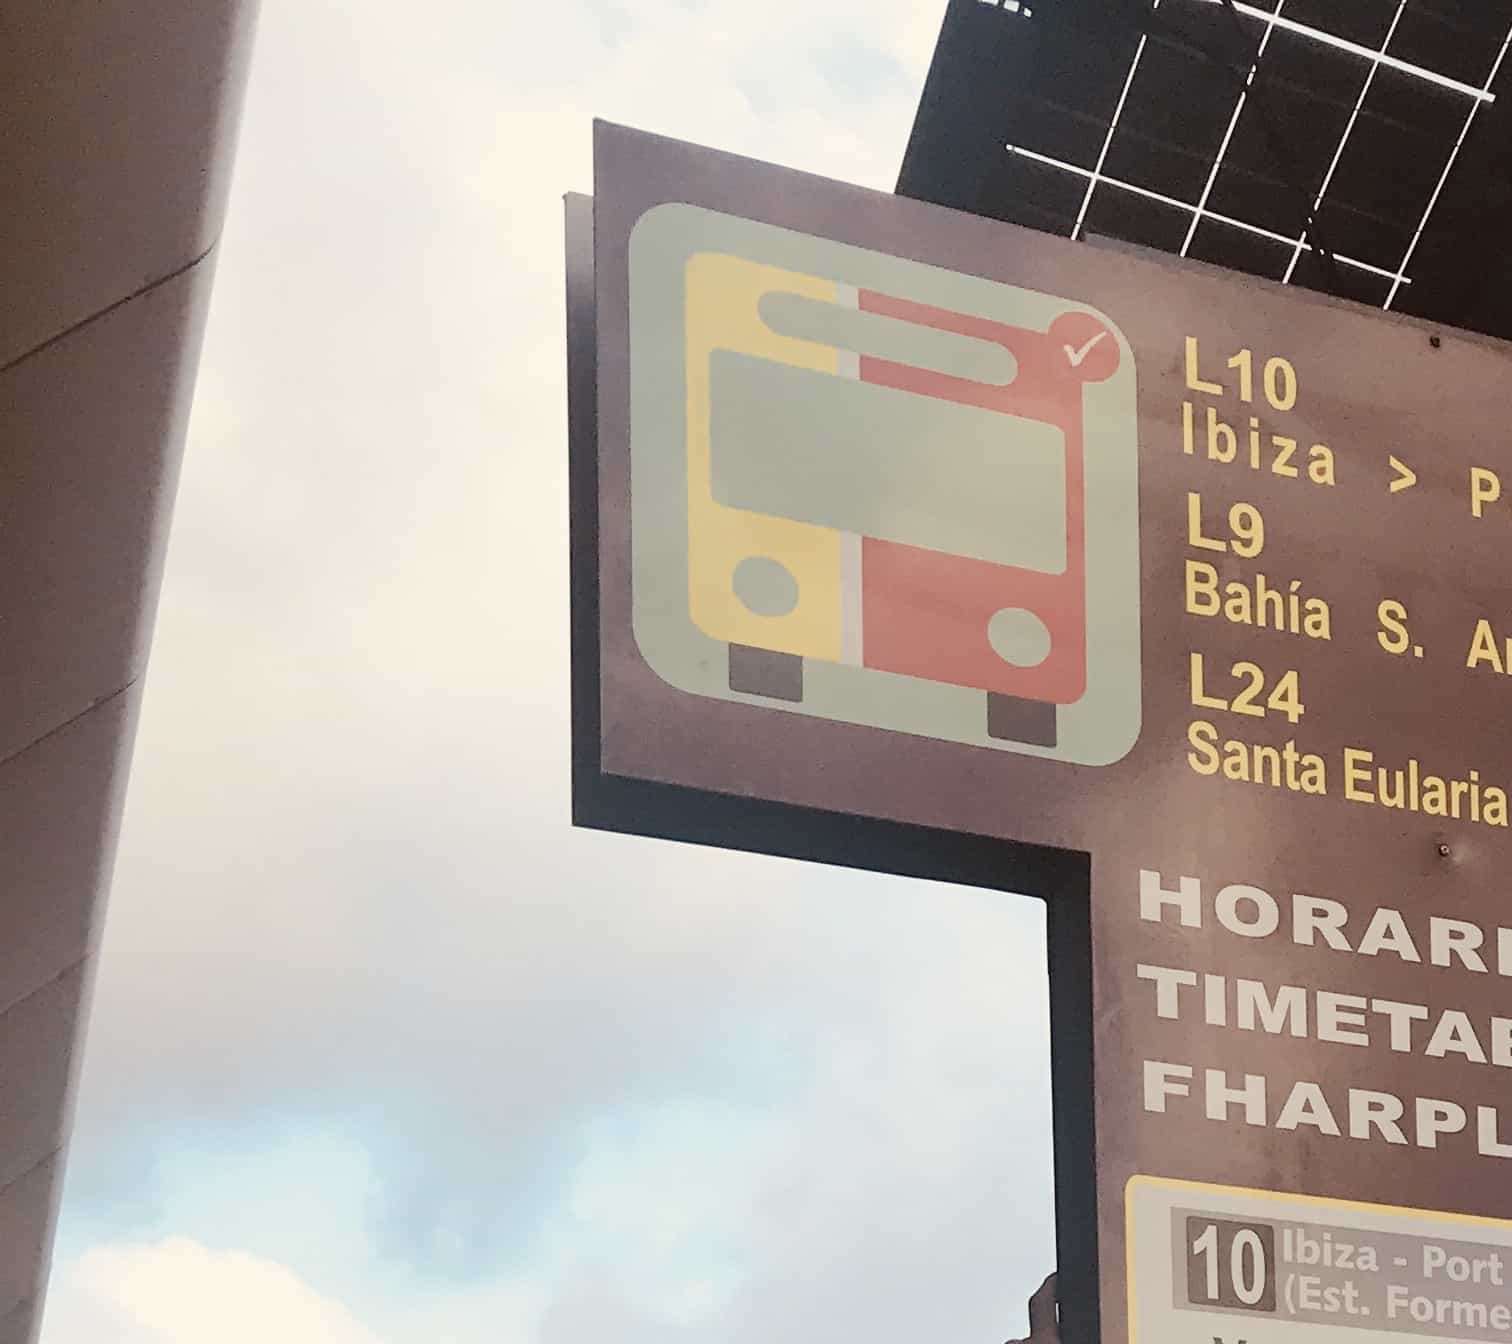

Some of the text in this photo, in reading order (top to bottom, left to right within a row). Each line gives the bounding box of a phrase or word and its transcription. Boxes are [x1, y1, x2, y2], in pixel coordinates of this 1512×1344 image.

[1184, 336, 1297, 410] L10
[1181, 403, 1335, 486] Ibiza
[1187, 493, 1265, 558] L9
[1185, 561, 1332, 640] Bahía
[1379, 600, 1424, 658] S.
[1190, 653, 1305, 724] L24
[1187, 722, 1327, 794] Santa
[1344, 748, 1509, 827] Eularia
[1192, 1225, 1266, 1306] 10
[1282, 1229, 1379, 1273] Ibiza
[1423, 1244, 1503, 1286] Port
[1285, 1274, 1370, 1316] (Est.
